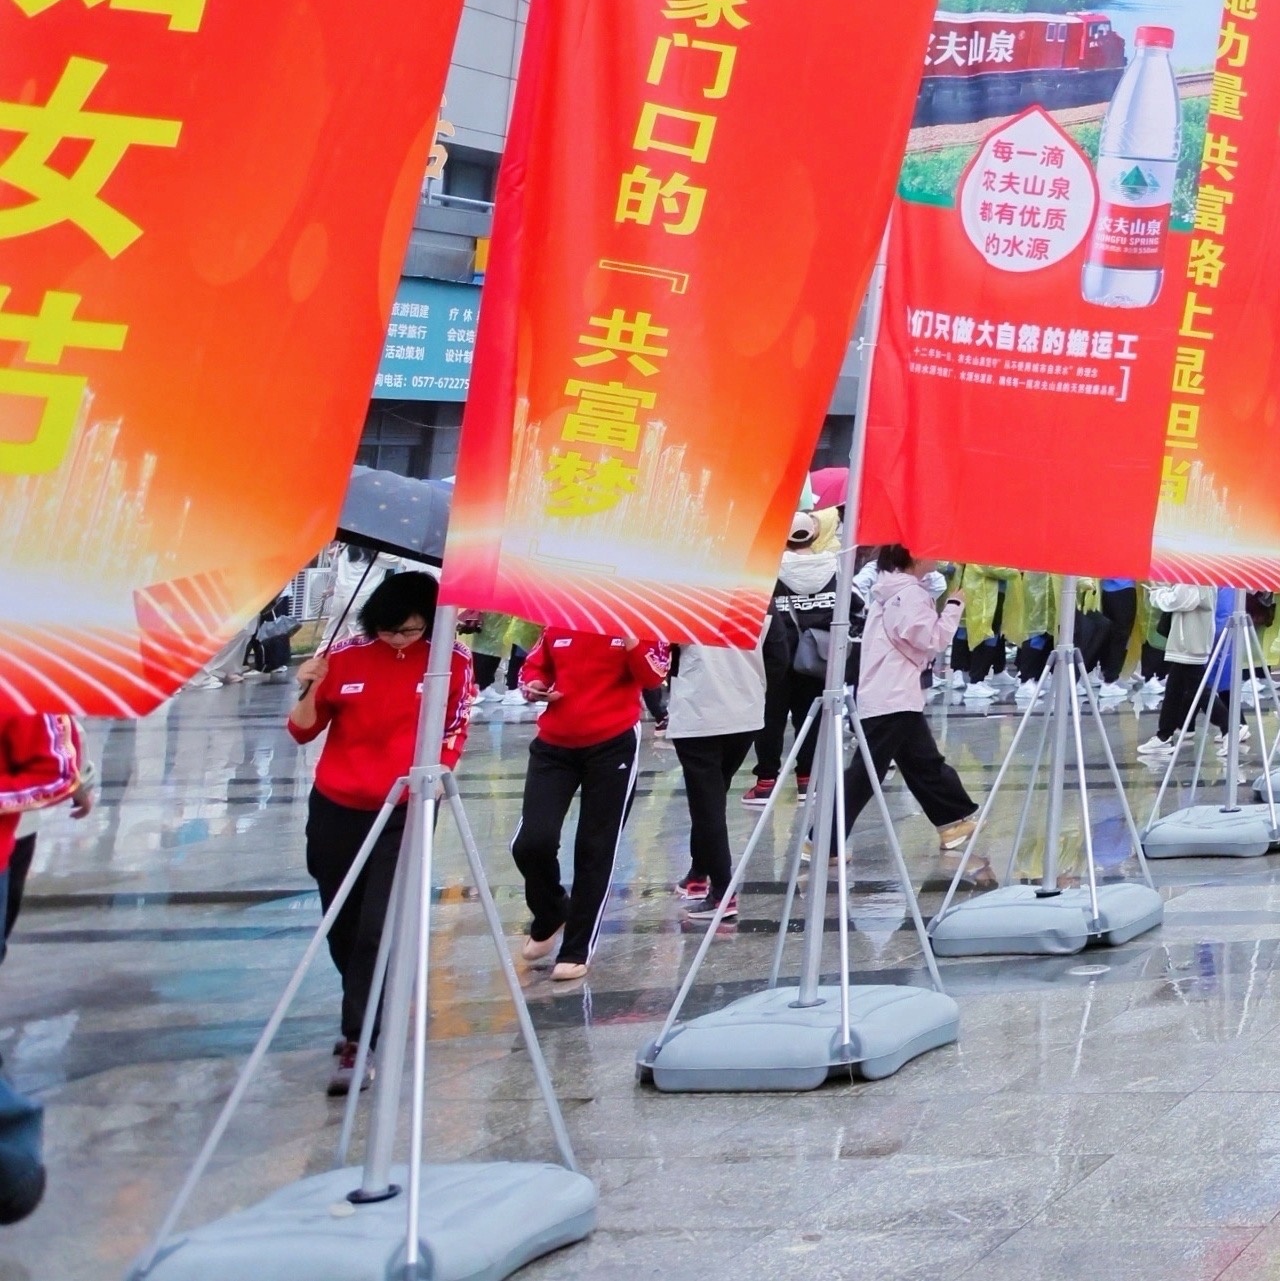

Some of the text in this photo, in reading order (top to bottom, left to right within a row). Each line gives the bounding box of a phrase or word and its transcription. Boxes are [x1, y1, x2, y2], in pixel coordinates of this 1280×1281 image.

[992, 138, 1065, 170] 每一滴
[982, 169, 1071, 201] 农夫山泉
[979, 201, 1068, 232] 都有优质
[1098, 216, 1162, 236] 农夫山泉
[985, 233, 1051, 262] 的水源
[1129, 237, 1160, 246] SPRING
[392, 302, 430, 318] 旅游团建
[388, 323, 427, 339] 研学旅行
[907, 305, 1139, 360] 们只做大自然的搬运工
[385, 344, 425, 360] 活动策划
[445, 348, 473, 364] 设计制
